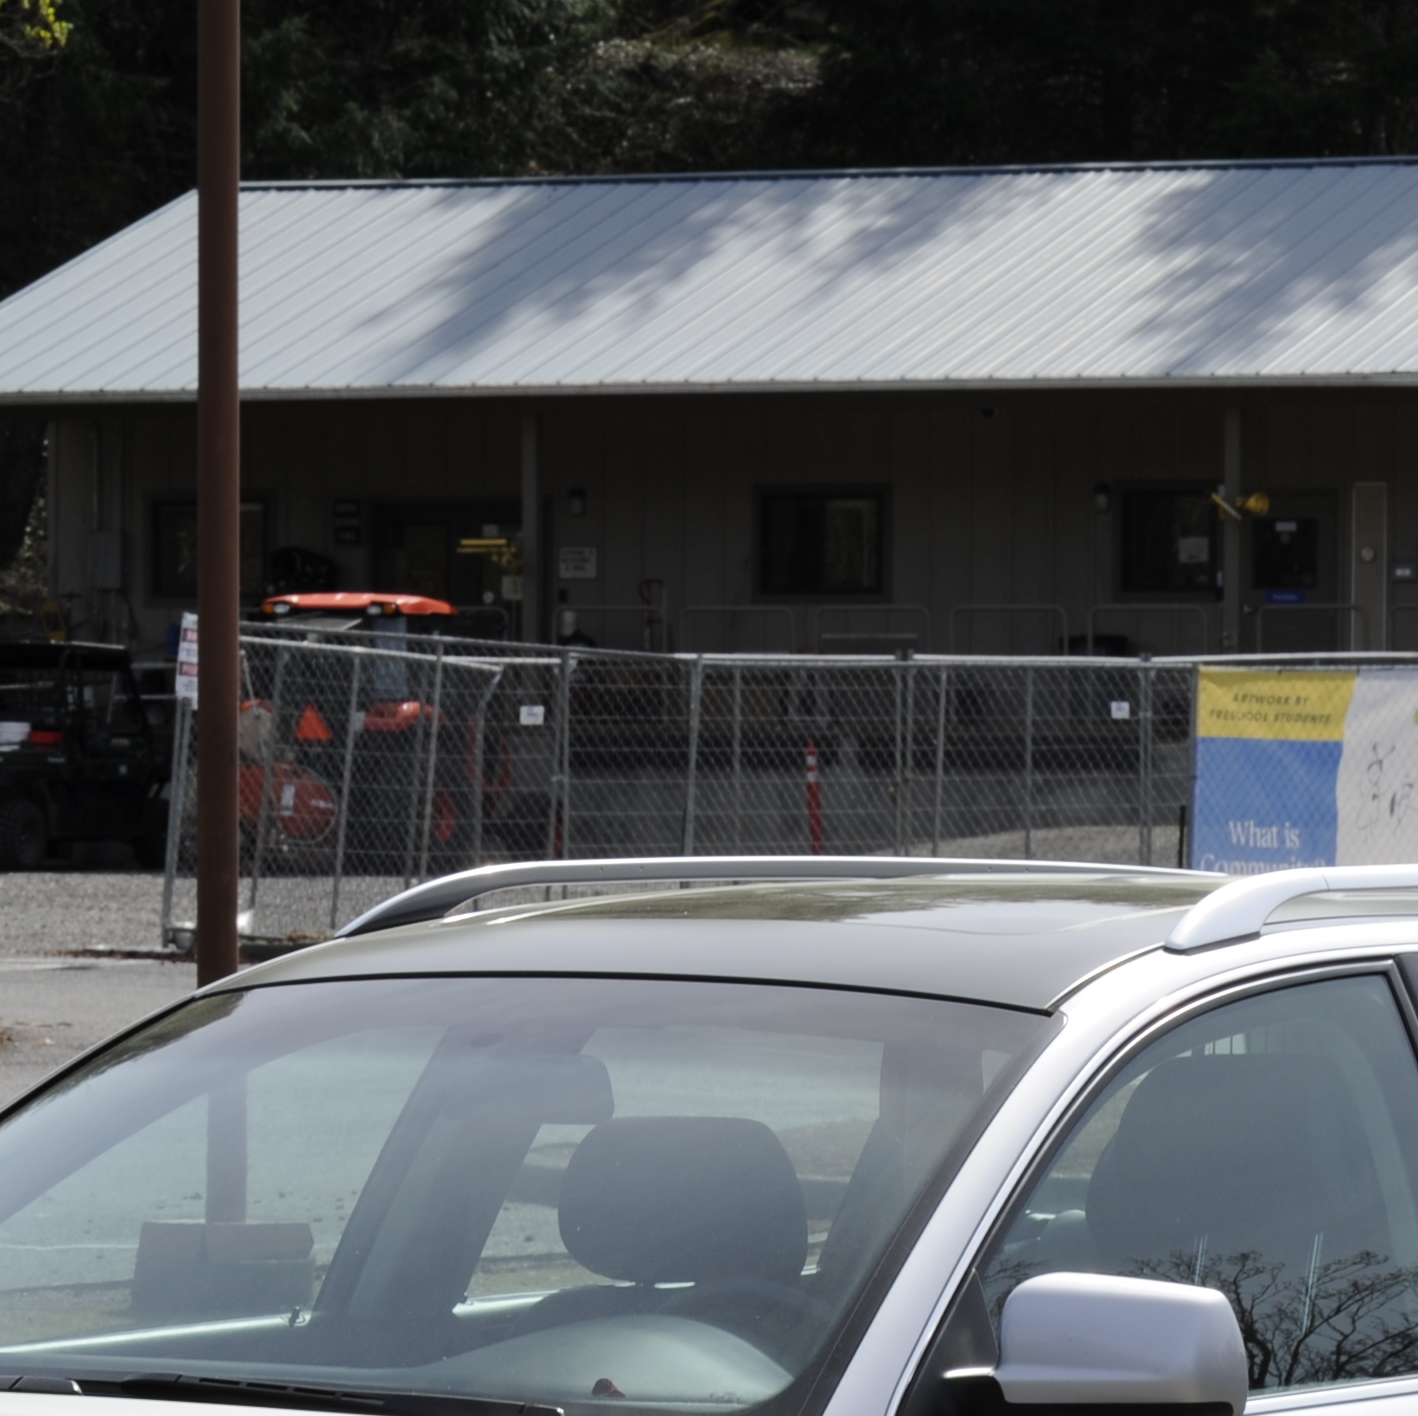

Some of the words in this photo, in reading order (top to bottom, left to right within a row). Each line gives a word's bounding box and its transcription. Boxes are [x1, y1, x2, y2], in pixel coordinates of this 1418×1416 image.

[1233, 693, 1290, 706] ARTWORK
[1295, 695, 1310, 706] BY
[1273, 713, 1332, 725] STUDENTS
[1228, 820, 1280, 848] What
[1284, 821, 1301, 849] is
